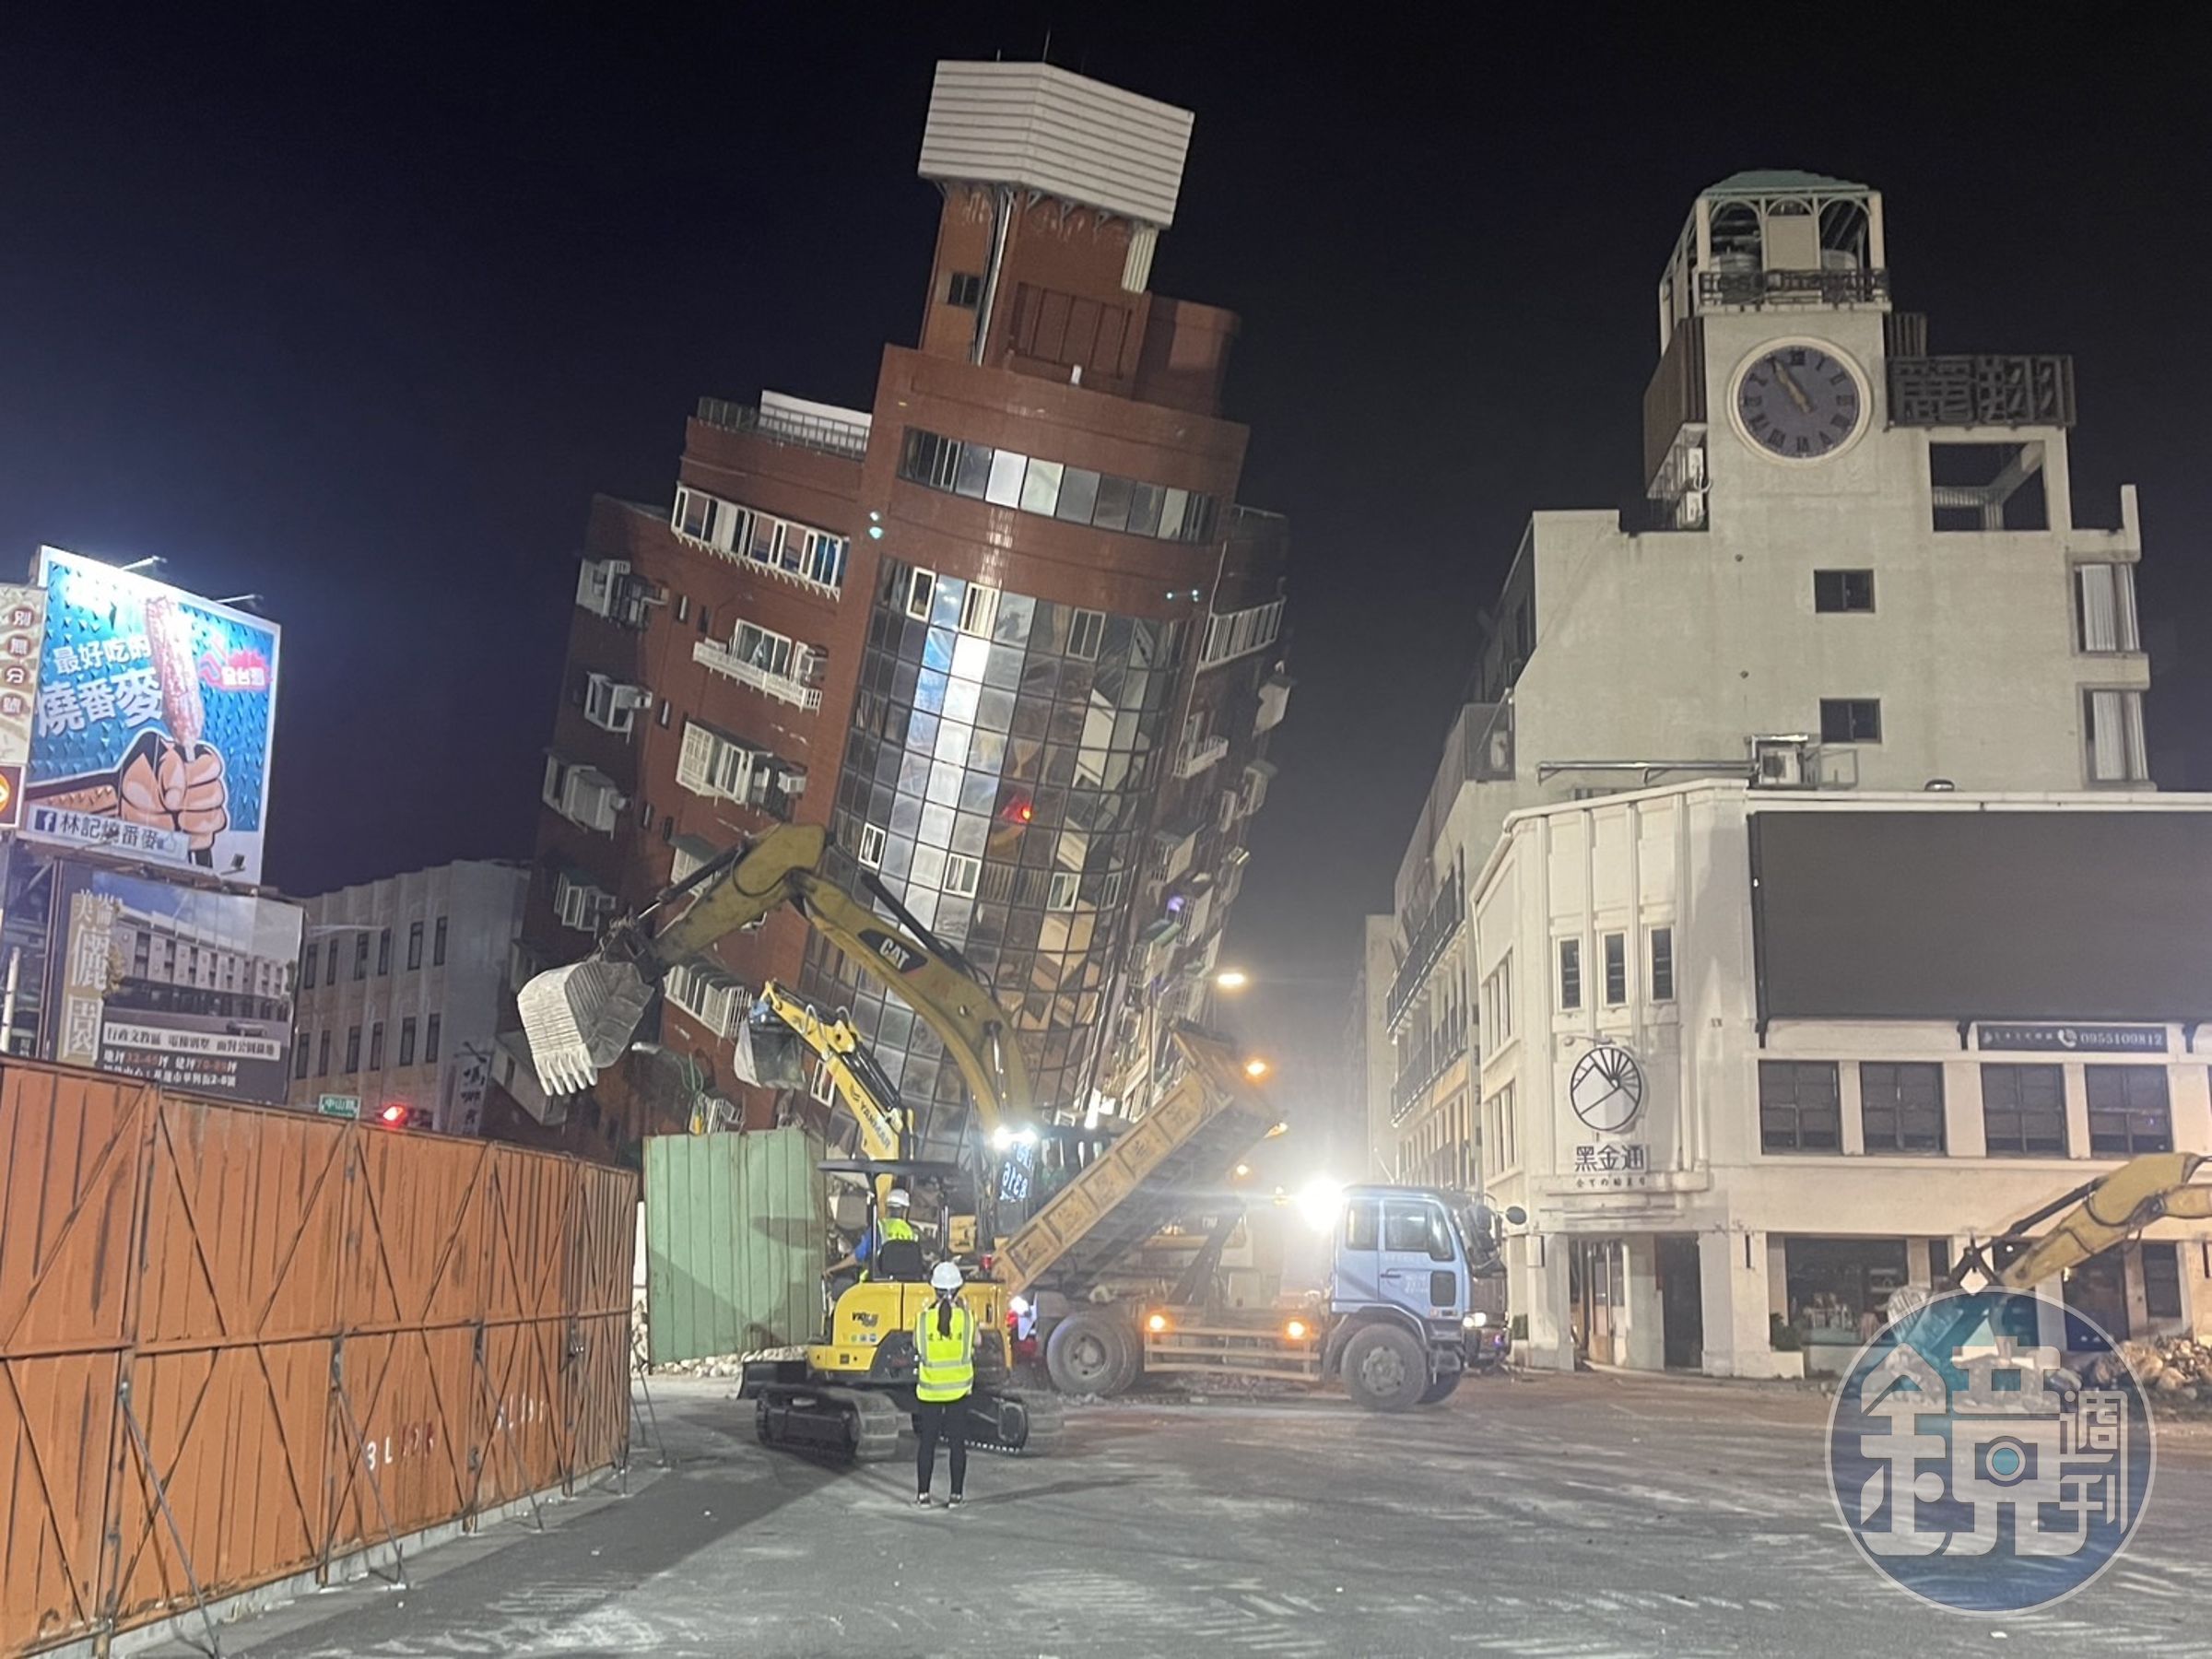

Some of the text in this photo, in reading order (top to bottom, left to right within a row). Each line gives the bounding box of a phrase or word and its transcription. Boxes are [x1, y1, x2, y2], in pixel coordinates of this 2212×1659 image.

[53, 636, 152, 675] 最好吃的
[879, 937, 911, 970] CAT
[1575, 1144, 1644, 1172] 黑金通
